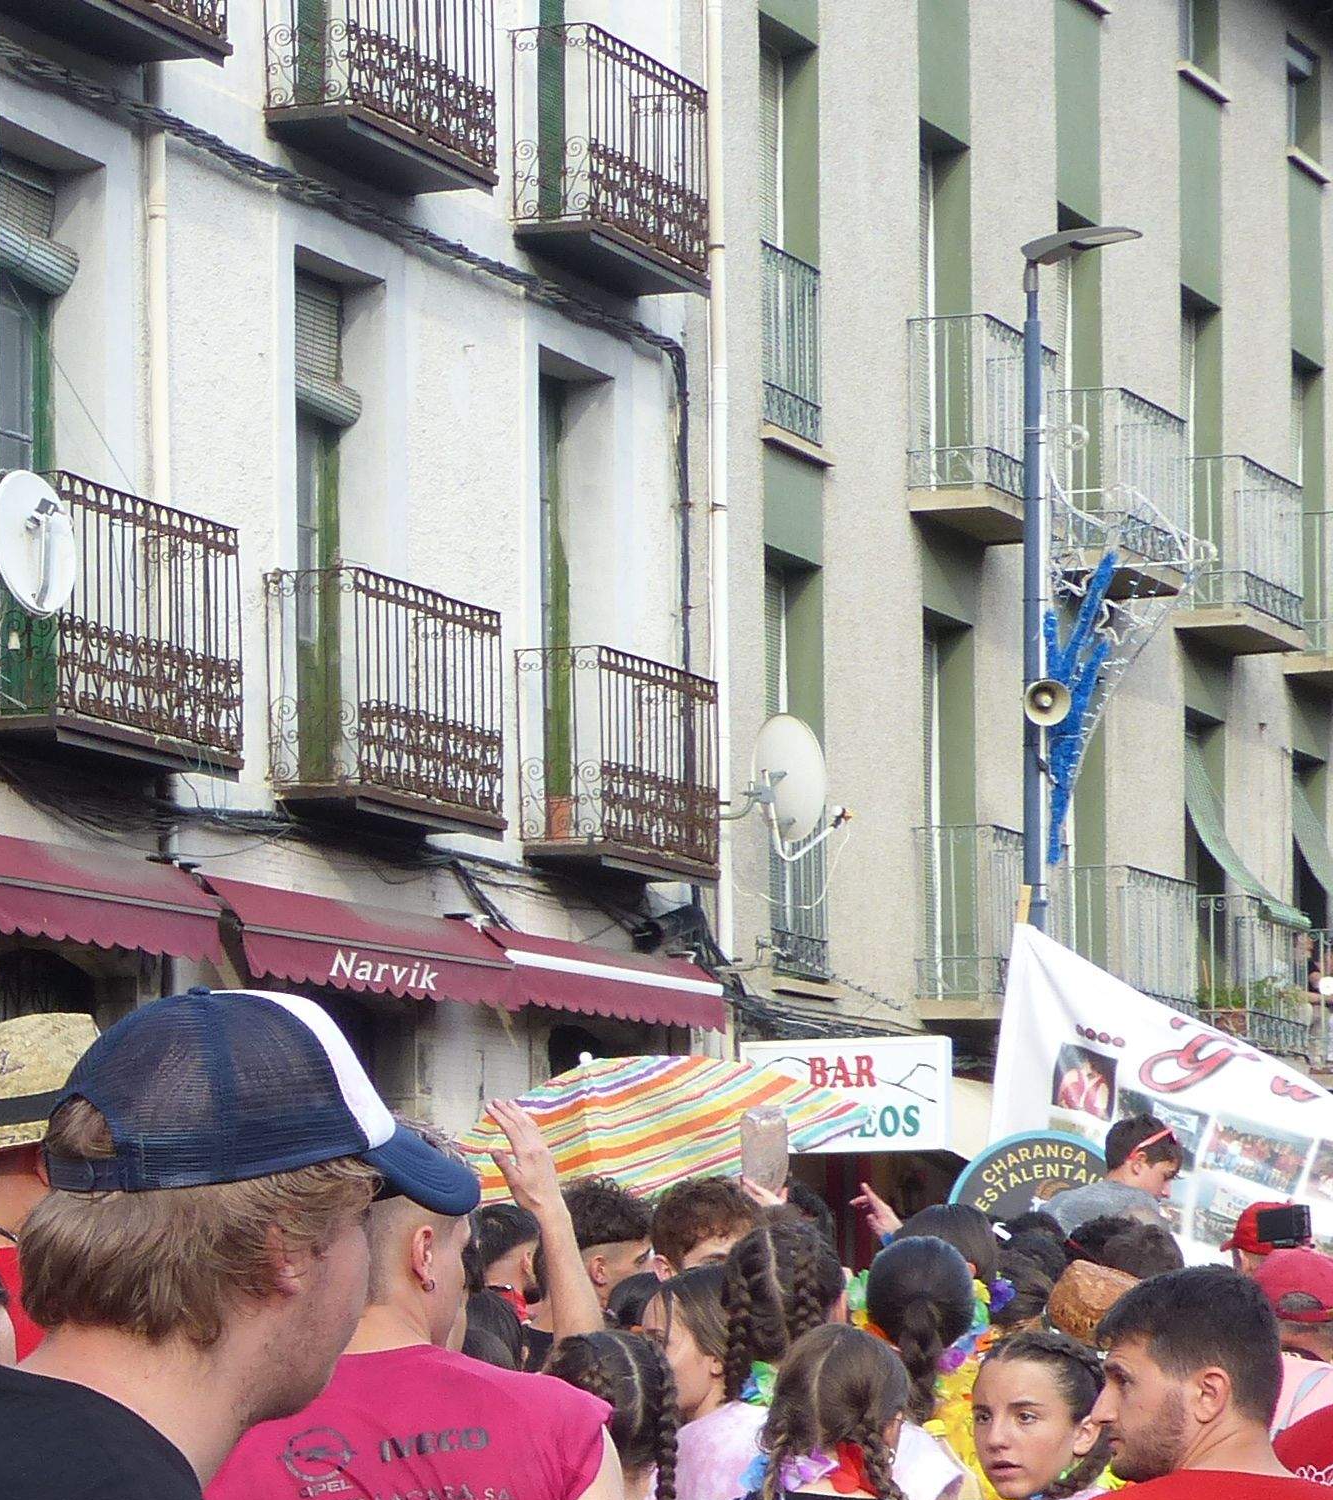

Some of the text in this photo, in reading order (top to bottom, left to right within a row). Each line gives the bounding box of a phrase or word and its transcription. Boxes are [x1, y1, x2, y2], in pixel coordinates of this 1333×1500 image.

[330, 947, 439, 993] Narvik
[808, 1054, 878, 1089] BAR
[981, 1144, 1089, 1184] CHARANGA
[378, 1427, 490, 1464] IVECO
